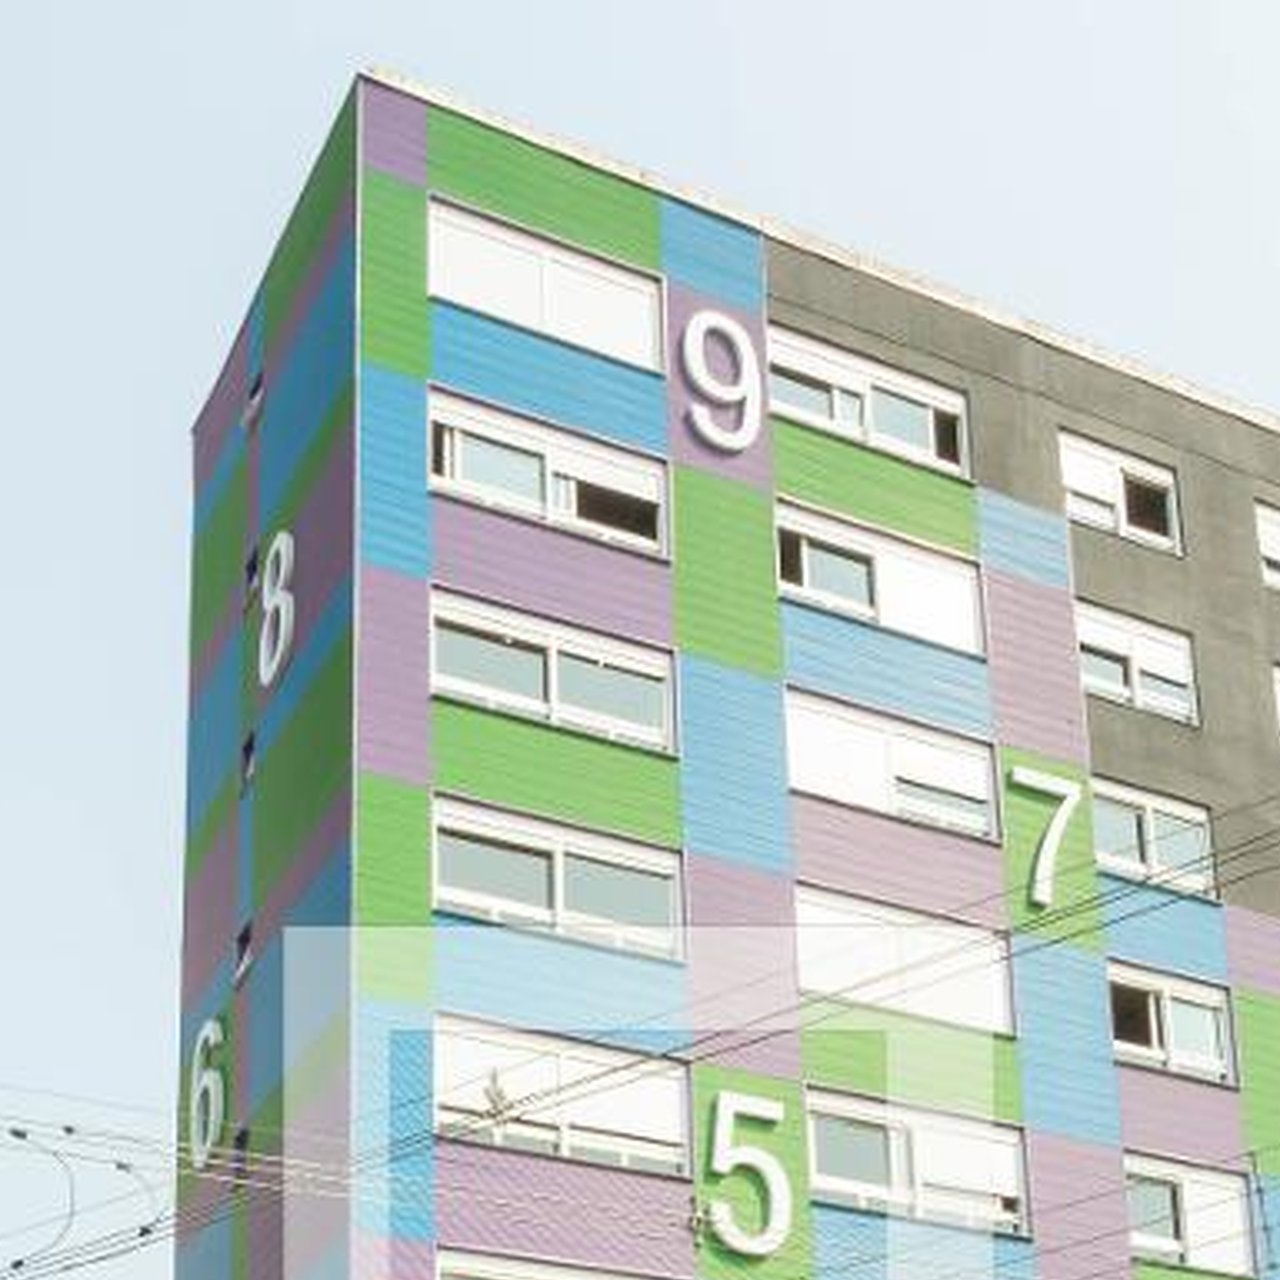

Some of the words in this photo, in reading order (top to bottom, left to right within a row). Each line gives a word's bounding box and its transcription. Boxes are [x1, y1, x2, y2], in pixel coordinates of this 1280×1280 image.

[682, 310, 763, 453] 9
[256, 530, 294, 688] 8
[1010, 766, 1082, 906] 7
[187, 1016, 226, 1168] 6
[708, 1090, 794, 1257] 5
